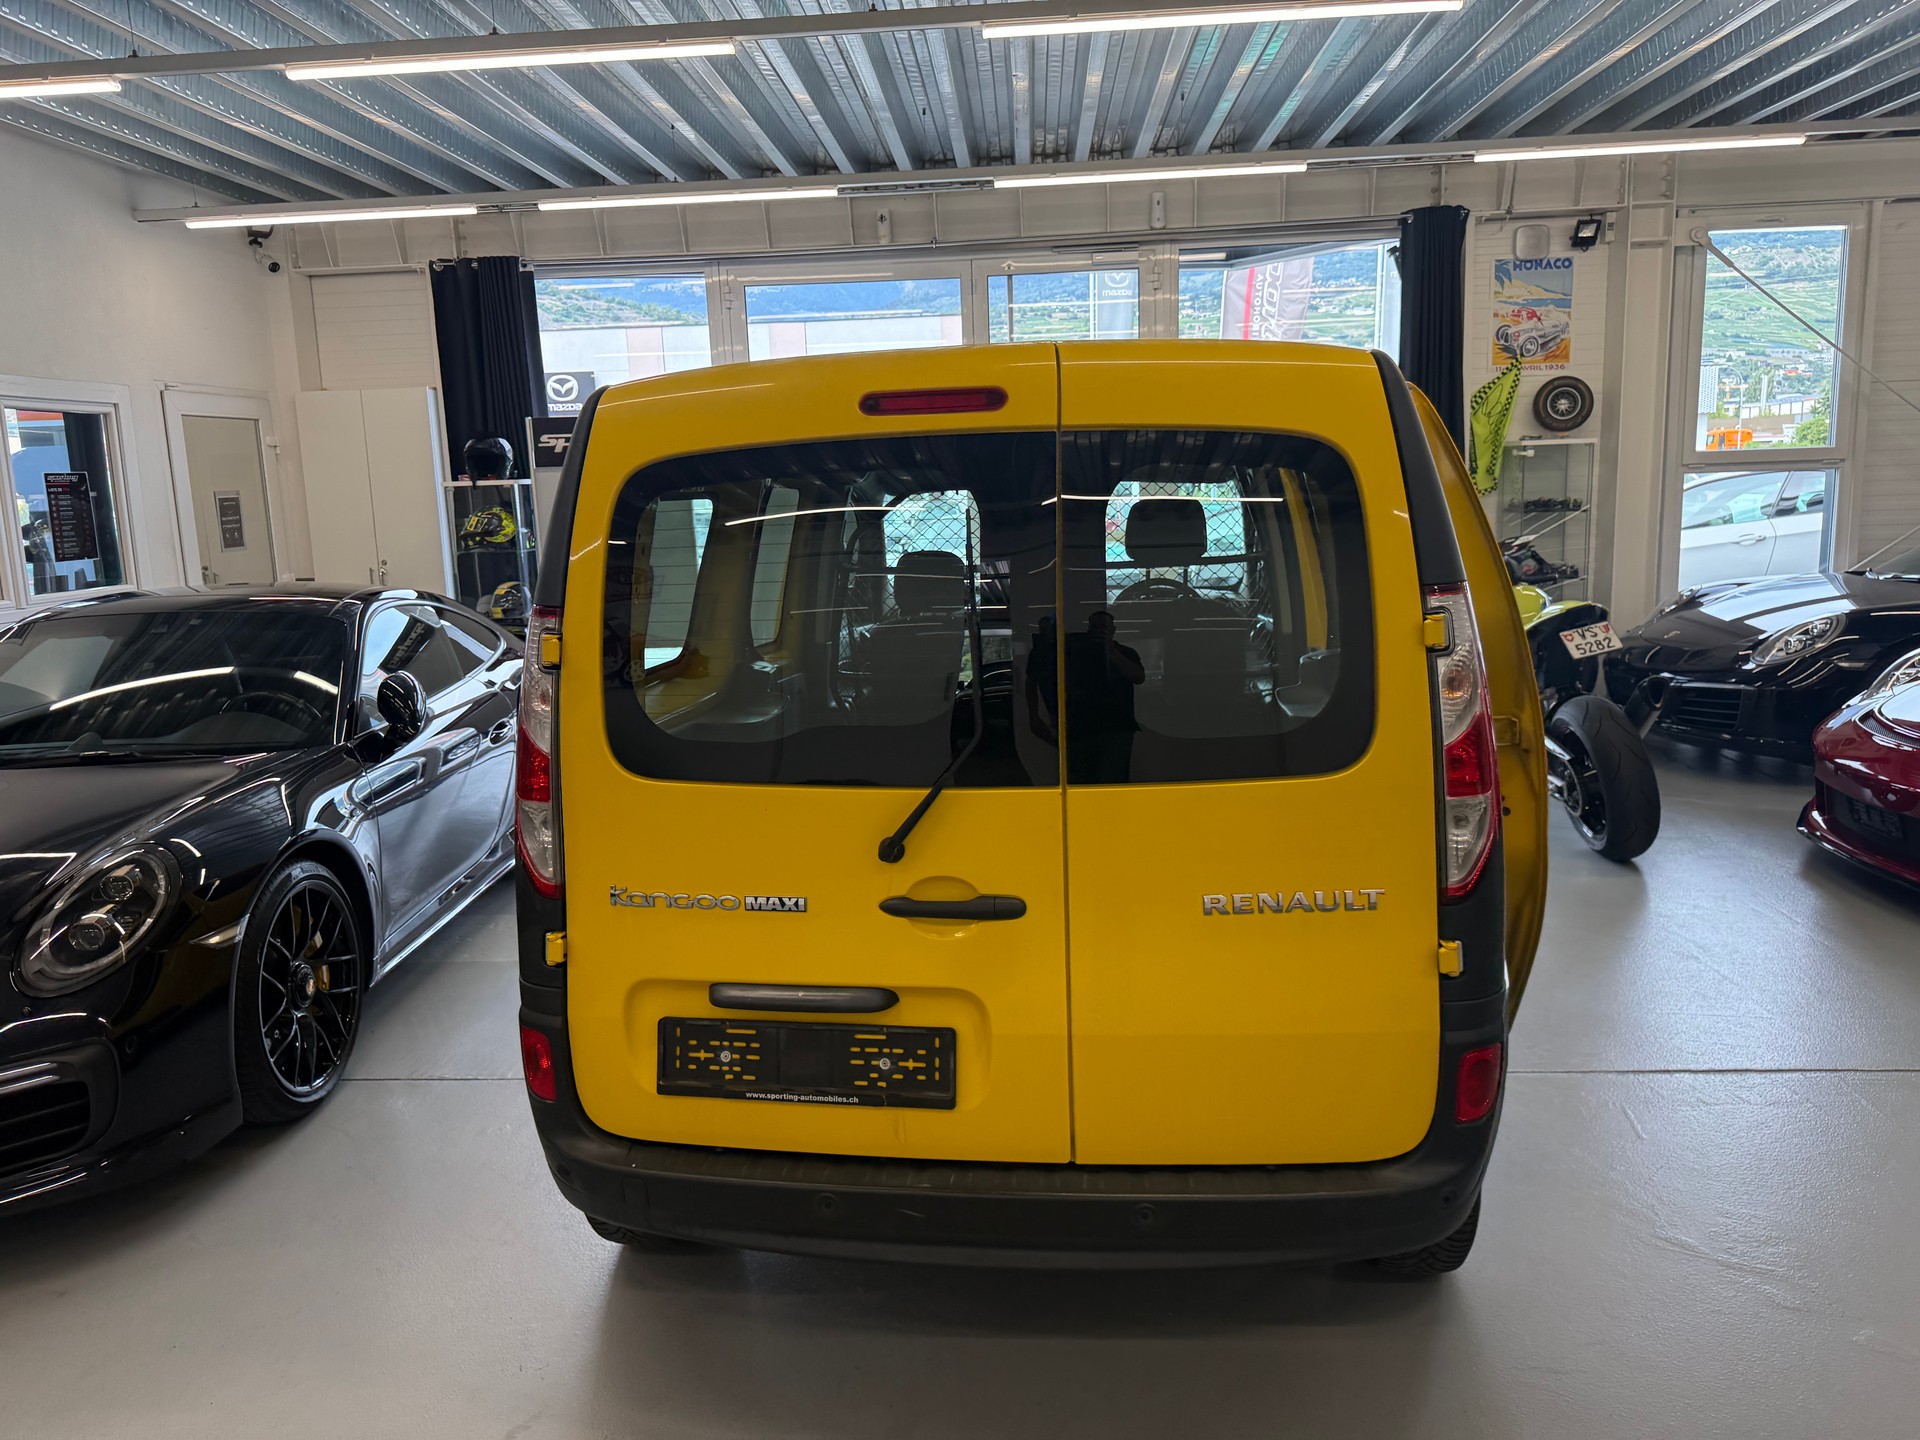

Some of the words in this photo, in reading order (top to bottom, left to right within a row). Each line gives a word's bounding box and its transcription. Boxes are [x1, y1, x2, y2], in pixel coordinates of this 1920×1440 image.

[1513, 257, 1573, 271] MONACO
[1252, 274, 1265, 336] AUTOMOBI
[1520, 363, 1544, 371] AVRIL
[1545, 363, 1566, 371] 1936
[1575, 636, 1616, 655] 5282
[745, 896, 807, 912] MAXI
[1201, 888, 1386, 916] RENAULT
[745, 1091, 859, 1104] www.sporting-automobiles.ch
